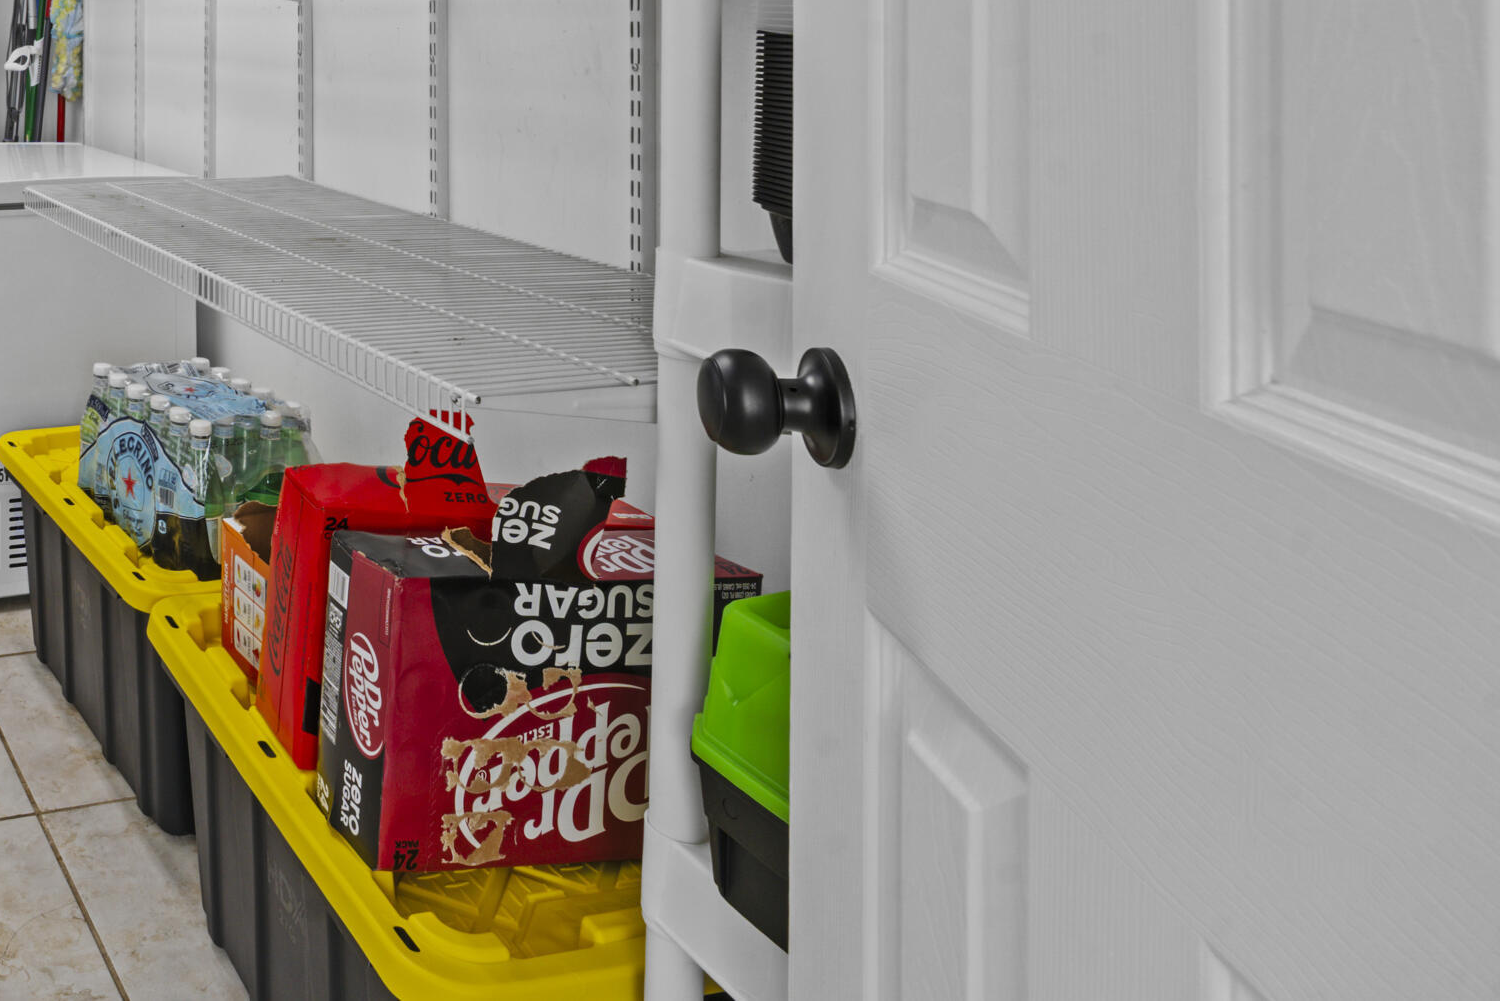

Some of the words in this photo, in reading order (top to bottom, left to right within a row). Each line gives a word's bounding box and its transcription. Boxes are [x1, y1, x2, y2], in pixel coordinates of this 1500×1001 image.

[324, 517, 349, 531] 24
[444, 491, 488, 504] ZERO
[349, 633, 379, 748] Pepper
[363, 676, 382, 728] Dr
[340, 759, 352, 827] SUGAR
[348, 767, 362, 837] zero
[523, 767, 608, 843] Dr
[394, 848, 420, 871] 24
